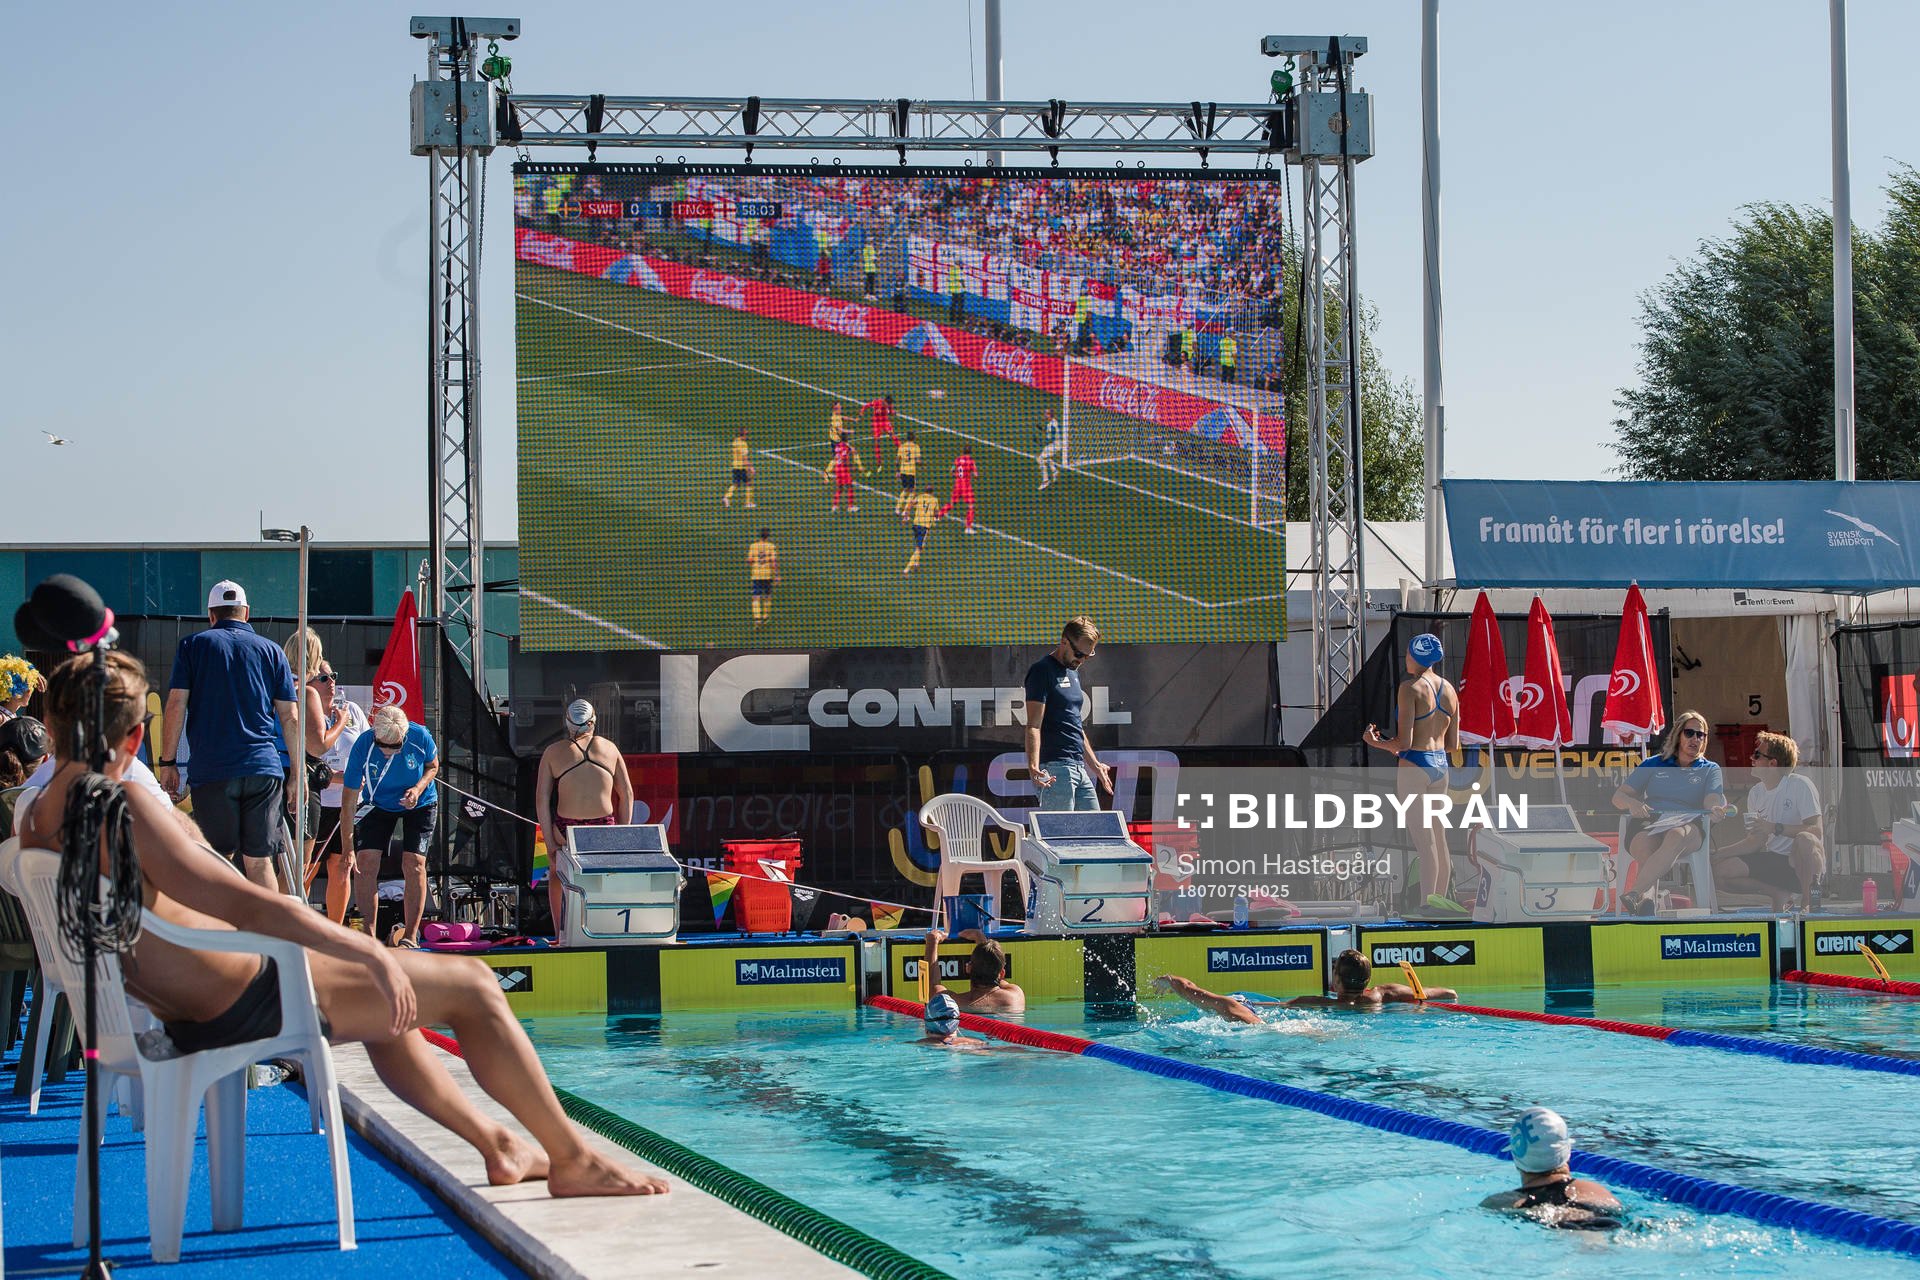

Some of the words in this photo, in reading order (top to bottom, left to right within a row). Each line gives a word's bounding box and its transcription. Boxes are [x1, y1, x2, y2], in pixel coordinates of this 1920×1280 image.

[630, 203, 639, 215] 0
[656, 203, 662, 215] 1
[678, 204, 706, 215] ENG
[741, 204, 775, 216] 58:03
[1050, 299, 1074, 315] CITY
[1479, 515, 1575, 543] Framåt
[1578, 517, 1618, 545] för
[1622, 517, 1671, 545] fler
[1674, 518, 1682, 545] i
[1688, 517, 1785, 545] rörelse!
[1826, 530, 1862, 539] SVENSK
[1828, 538, 1875, 547] SIMIDROTT
[660, 654, 810, 753] IC
[808, 685, 1132, 728] CONTRL
[1748, 695, 1762, 716] 5
[1866, 770, 1914, 788] SVENSKA
[1159, 848, 1173, 870] 2
[1907, 869, 1916, 894] 4
[1534, 887, 1559, 911] 3
[1080, 897, 1105, 923] 2
[616, 908, 631, 933] 1
[1684, 940, 1757, 954] Malmsten
[1816, 935, 1866, 953] arena
[1231, 952, 1309, 967] Malmsten
[1373, 946, 1425, 965] arena
[760, 963, 841, 979] Malmsten
[904, 959, 959, 978] ana
